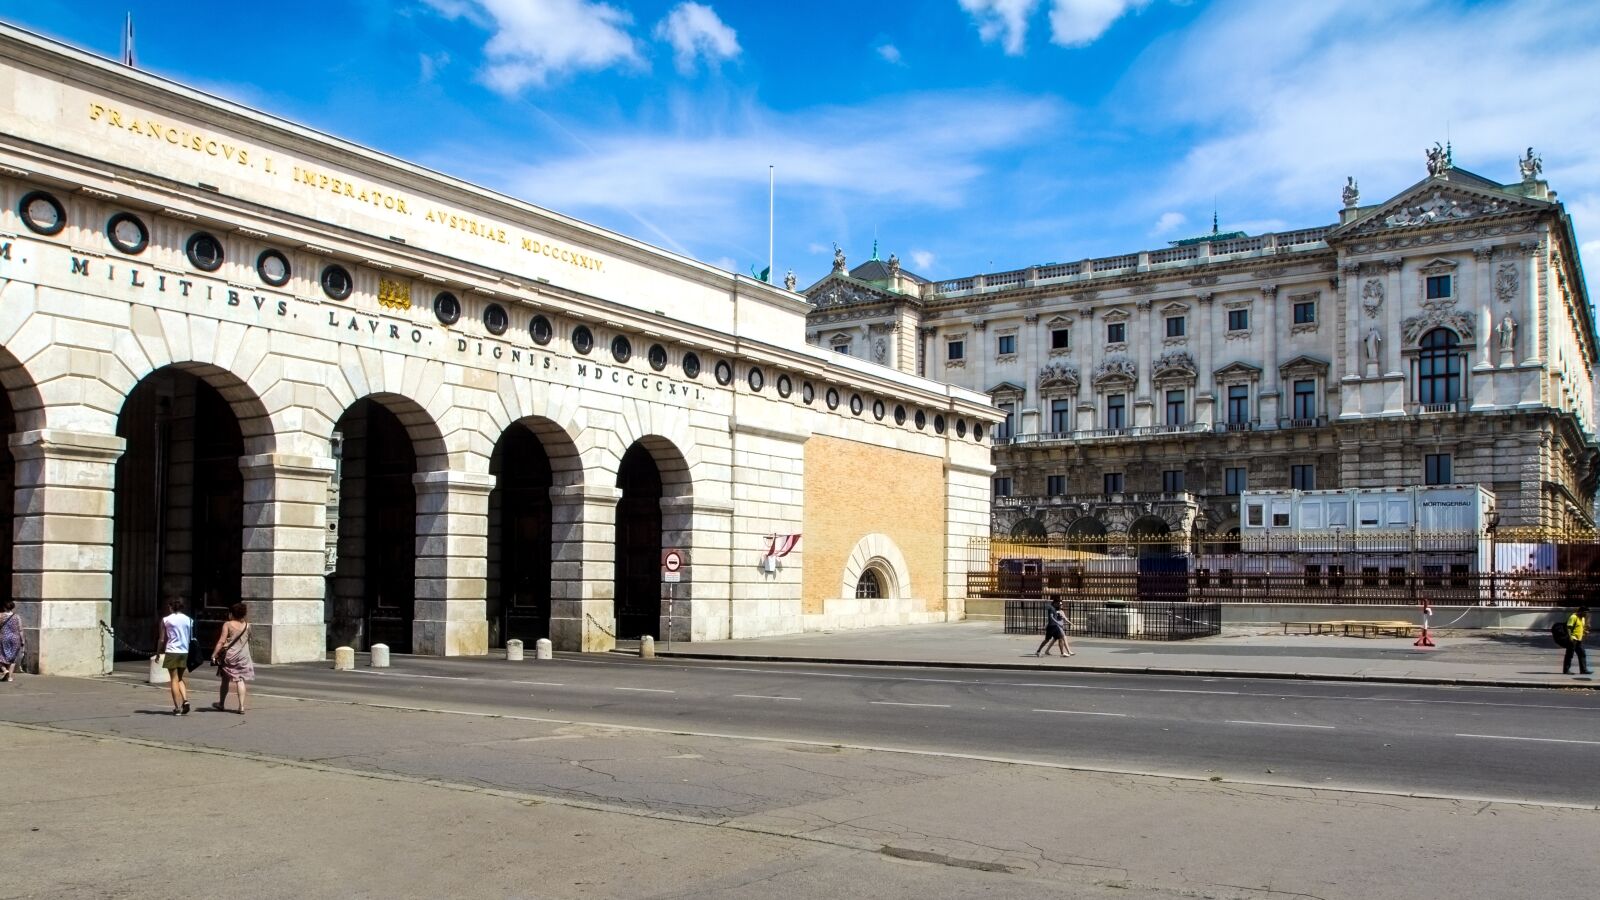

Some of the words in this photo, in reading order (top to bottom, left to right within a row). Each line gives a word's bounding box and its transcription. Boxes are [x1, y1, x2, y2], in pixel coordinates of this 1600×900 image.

[71, 256, 298, 319] MILITIBVS.
[328, 311, 433, 346] LAVRO.
[457, 338, 558, 371] DIGNIS.
